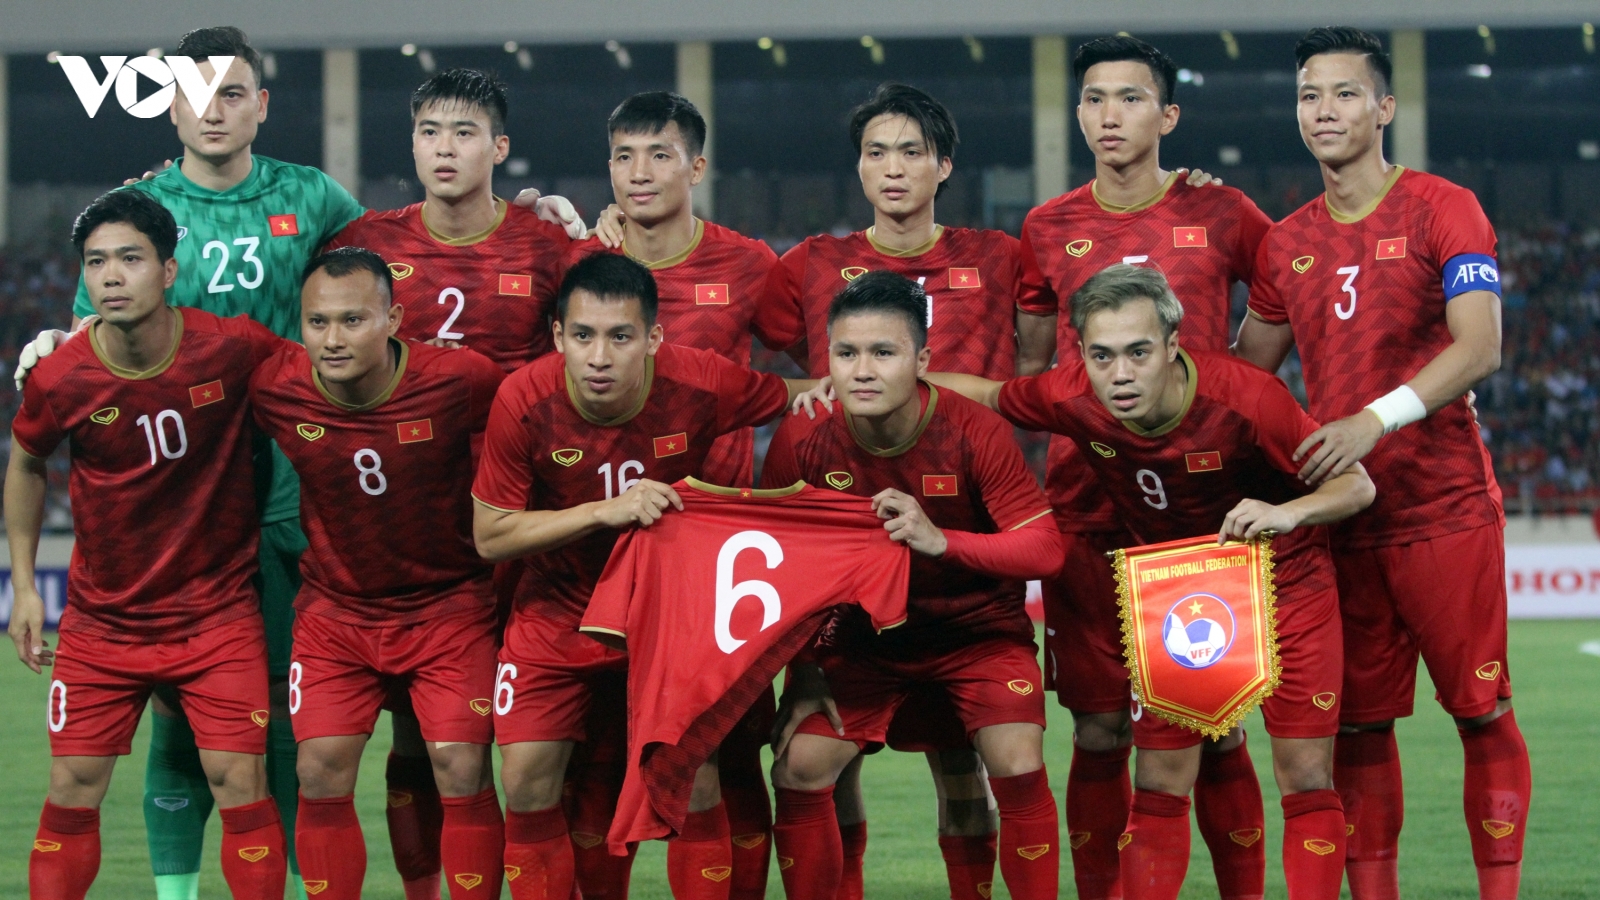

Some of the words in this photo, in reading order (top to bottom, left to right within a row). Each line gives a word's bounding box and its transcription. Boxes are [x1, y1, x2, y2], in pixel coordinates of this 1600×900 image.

[202, 236, 265, 293] 23
[1452, 263, 1498, 288] AFC
[437, 287, 465, 339] 2
[1334, 265, 1360, 320] 3
[136, 409, 188, 466] 10
[353, 448, 387, 496] 8
[598, 460, 645, 500] 16
[1136, 469, 1167, 510] 9
[714, 530, 784, 654] 6
[1140, 567, 1170, 583] VIETNAM
[1170, 561, 1204, 578] FOOTBALL
[1205, 555, 1247, 572] FEDERATION
[1190, 647, 1211, 659] VFF
[289, 661, 302, 714] 8
